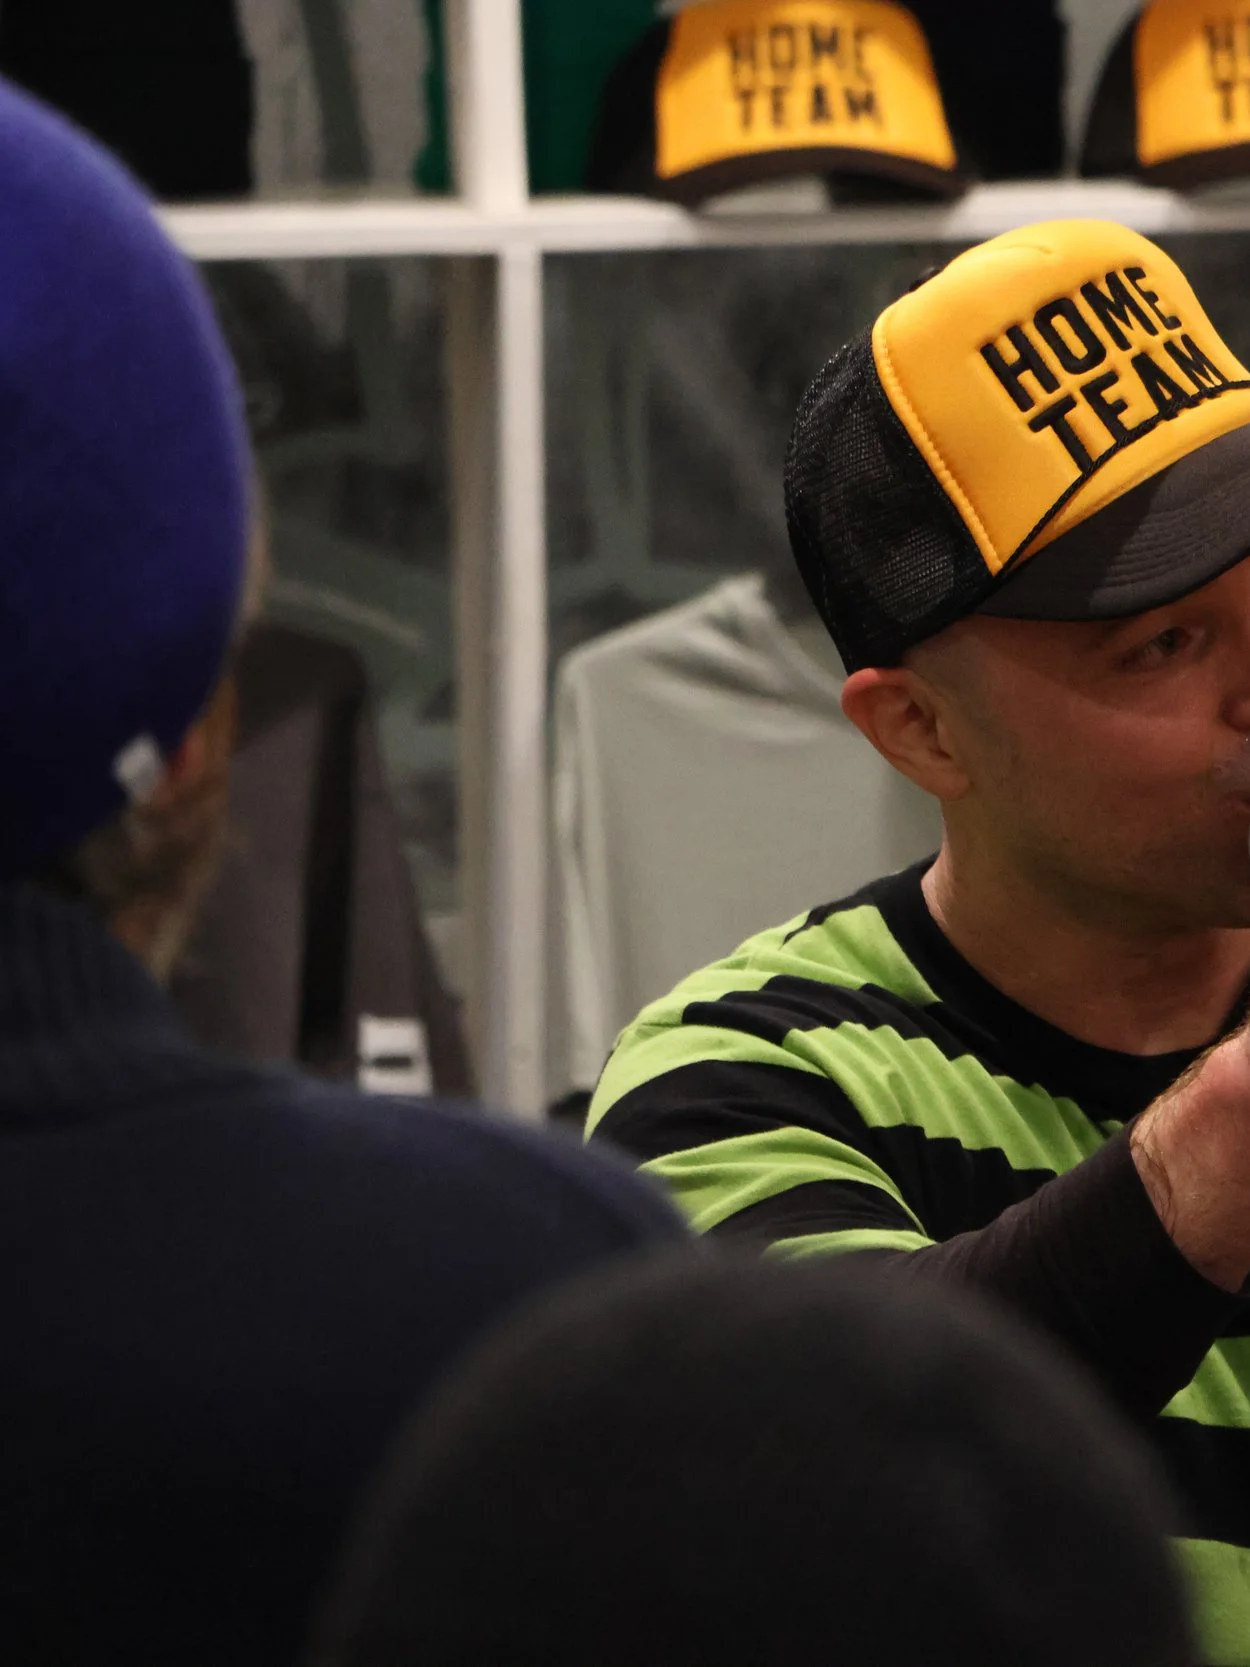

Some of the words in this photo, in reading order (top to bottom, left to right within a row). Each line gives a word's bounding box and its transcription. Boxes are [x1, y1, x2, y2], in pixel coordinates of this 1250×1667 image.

[726, 22, 875, 87] HOME
[736, 83, 882, 133] TEAM
[979, 266, 1182, 412] HOME
[1028, 333, 1226, 476] TEAM
